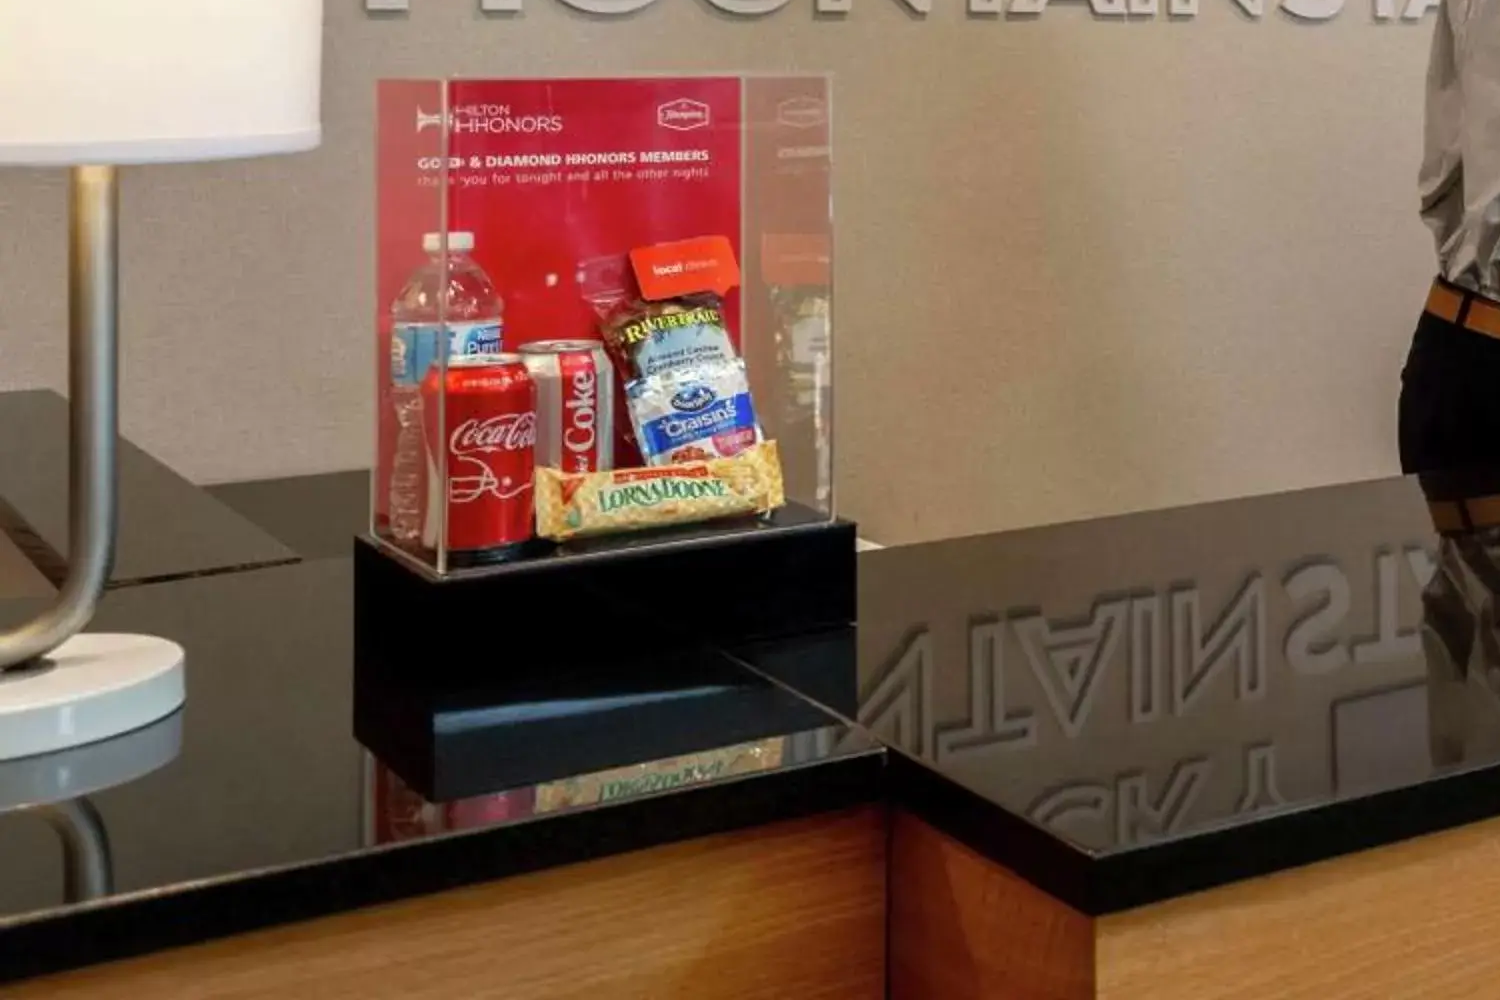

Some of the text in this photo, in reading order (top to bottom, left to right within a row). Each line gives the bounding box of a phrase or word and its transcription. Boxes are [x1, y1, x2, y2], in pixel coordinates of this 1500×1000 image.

[455, 103, 511, 116] HILTON
[469, 155, 482, 169] &
[485, 153, 562, 168] DIAMOND
[565, 151, 637, 166] HHONORS
[639, 149, 709, 164] MEMBERS
[460, 174, 487, 188] you
[492, 171, 511, 185] for
[515, 170, 562, 186] tonight
[566, 170, 591, 182] and
[593, 168, 610, 182] all
[612, 168, 633, 181] the
[563, 369, 596, 453] Coke
